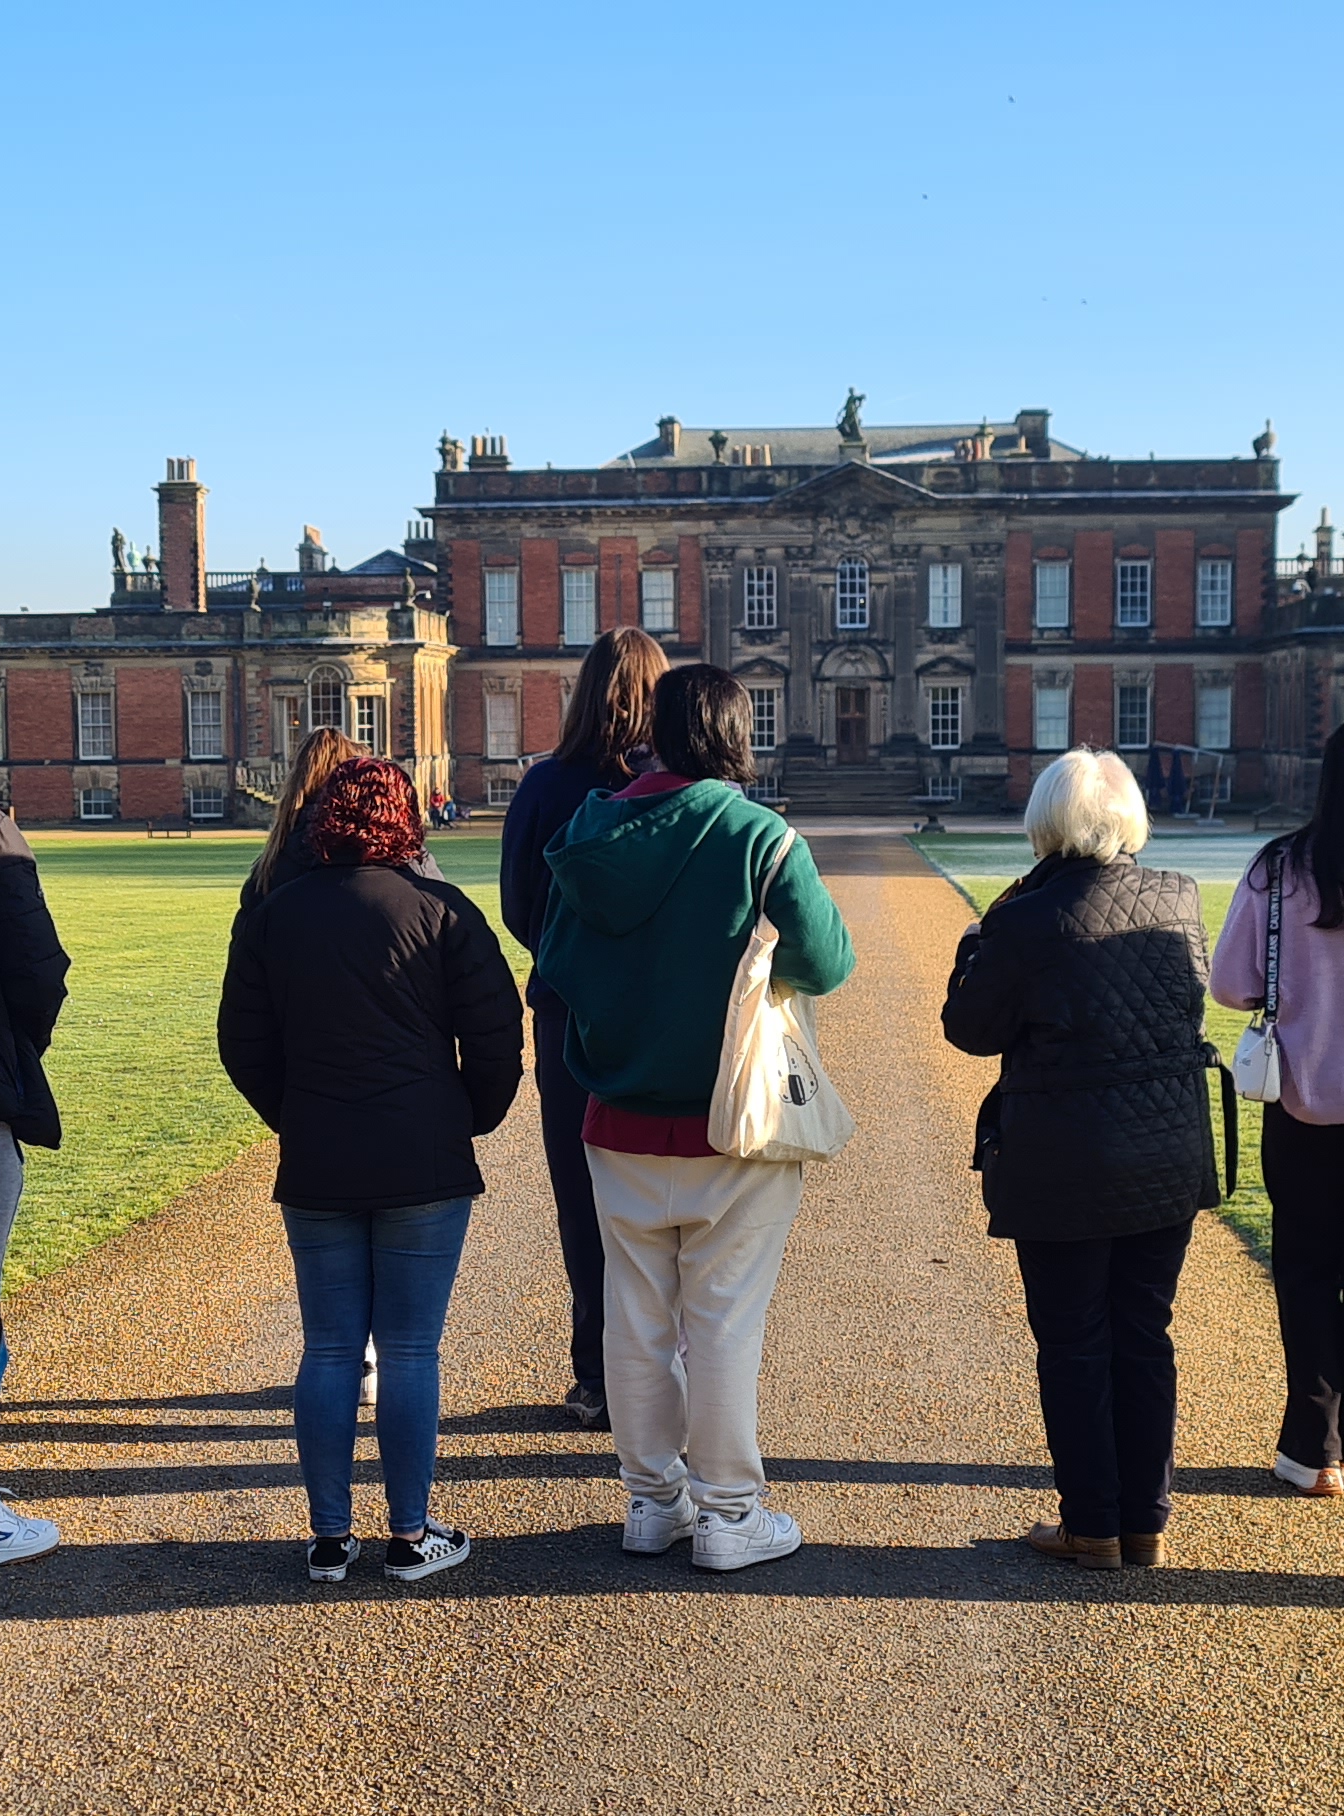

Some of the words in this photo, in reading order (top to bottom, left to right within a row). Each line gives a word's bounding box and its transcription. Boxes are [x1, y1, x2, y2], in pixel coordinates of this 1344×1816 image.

[1269, 902, 1279, 930] CALVIN
[1268, 934, 1279, 960] JEANS
[1268, 959, 1277, 983] KLEIN
[1267, 983, 1276, 1011] CALVIN
